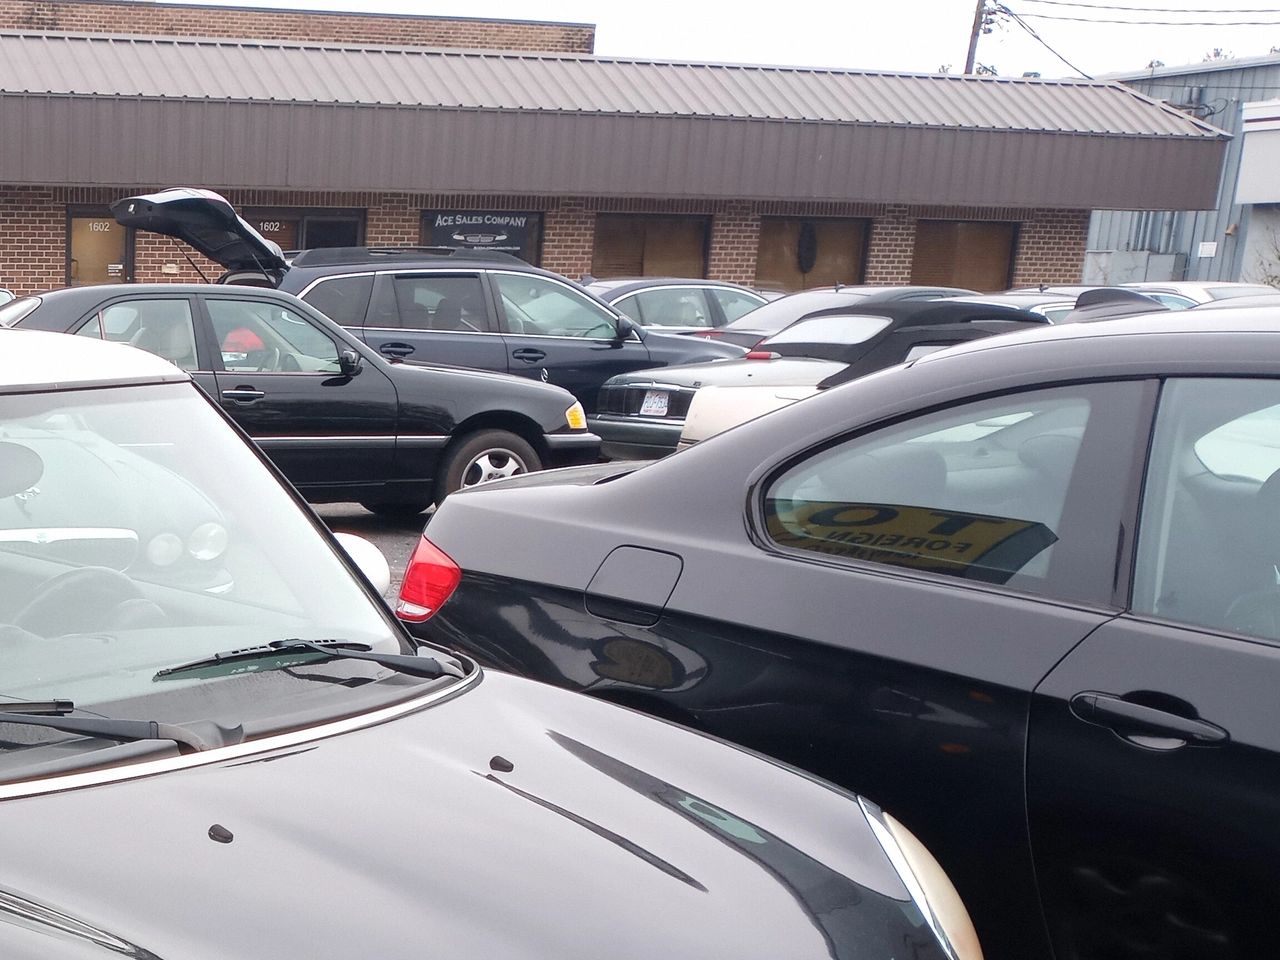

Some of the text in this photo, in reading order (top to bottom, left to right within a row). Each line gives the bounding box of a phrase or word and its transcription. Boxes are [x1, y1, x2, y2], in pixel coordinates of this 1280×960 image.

[435, 214, 527, 227] ACE SALES COMPANY
[88, 222, 110, 232] 1602
[259, 221, 280, 232] 1602
